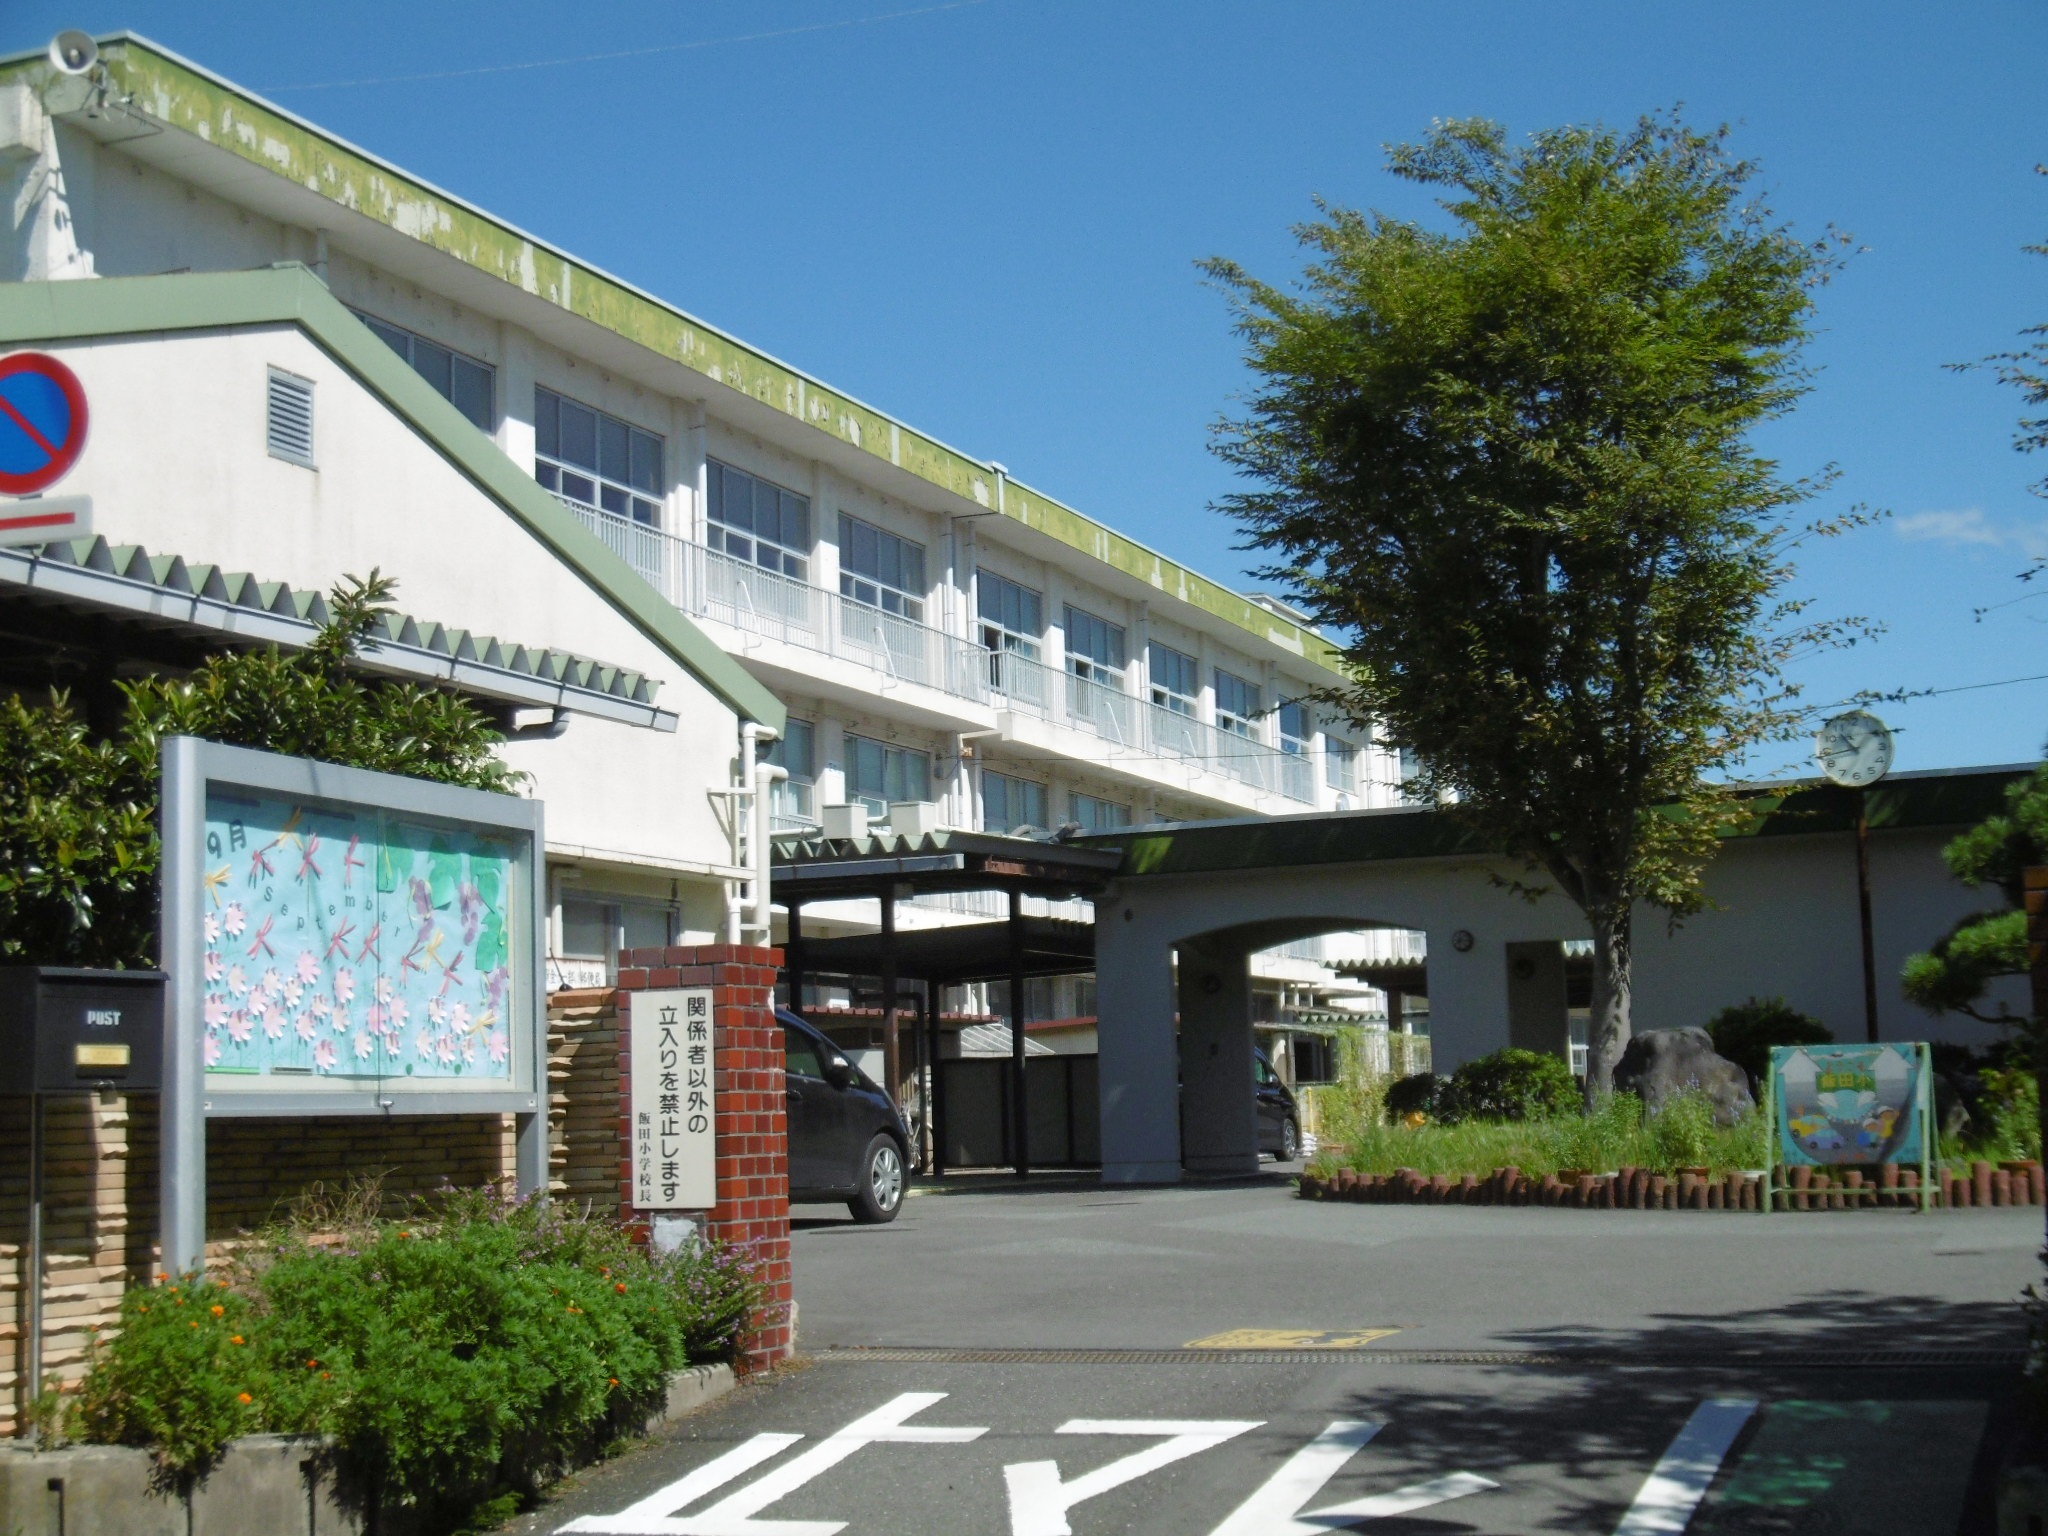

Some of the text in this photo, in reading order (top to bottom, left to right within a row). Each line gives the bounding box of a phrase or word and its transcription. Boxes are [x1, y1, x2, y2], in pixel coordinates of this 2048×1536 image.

[1825, 735, 1837, 743] 10
[1878, 743, 1886, 751] 3
[1827, 760, 1836, 768] 8
[1838, 769, 1847, 777] 7
[1852, 772, 1861, 780] 6
[1867, 766, 1876, 775] 5
[207, 819, 247, 859] 9月
[264, 886, 401, 938] September
[87, 1010, 121, 1026] POST
[687, 997, 709, 1134] 関係者以外の
[659, 1005, 680, 1202] 立入りを禁止します
[638, 1112, 652, 1203] 飯田小学校長
